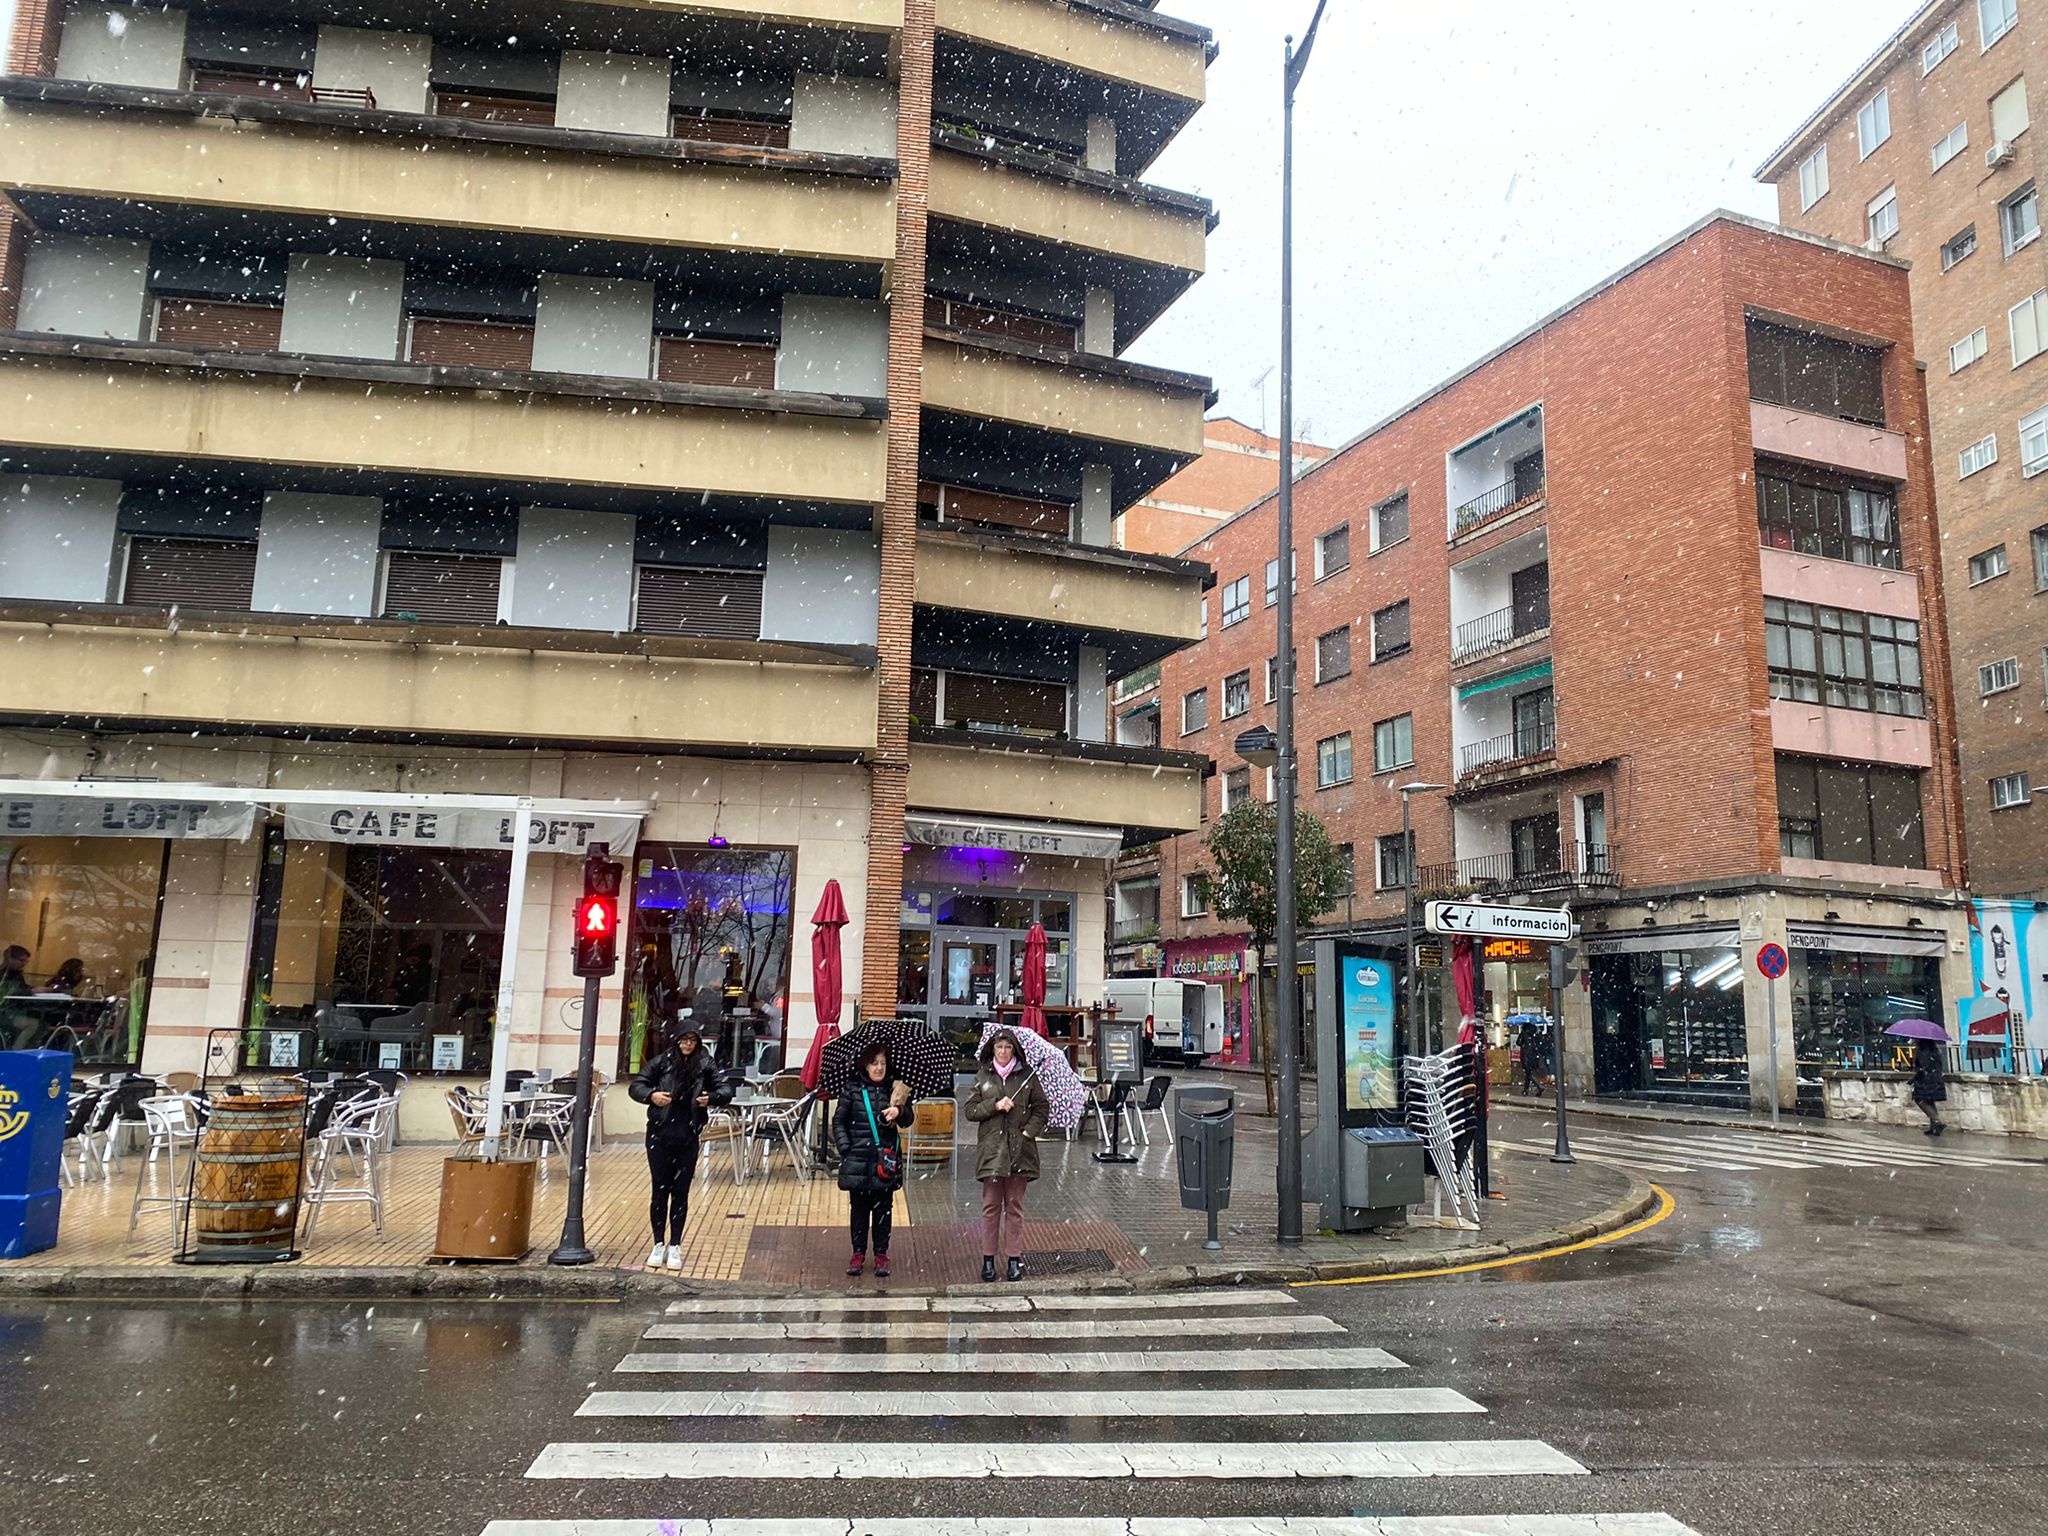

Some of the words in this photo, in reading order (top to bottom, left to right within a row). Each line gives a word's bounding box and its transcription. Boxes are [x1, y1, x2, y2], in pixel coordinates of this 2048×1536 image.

[0, 803, 33, 829] E
[102, 803, 208, 831] LOFT
[330, 809, 438, 839] CAFE
[498, 817, 595, 846] LOFT
[1019, 834, 1062, 851] LOFT
[1492, 914, 1567, 931] información
